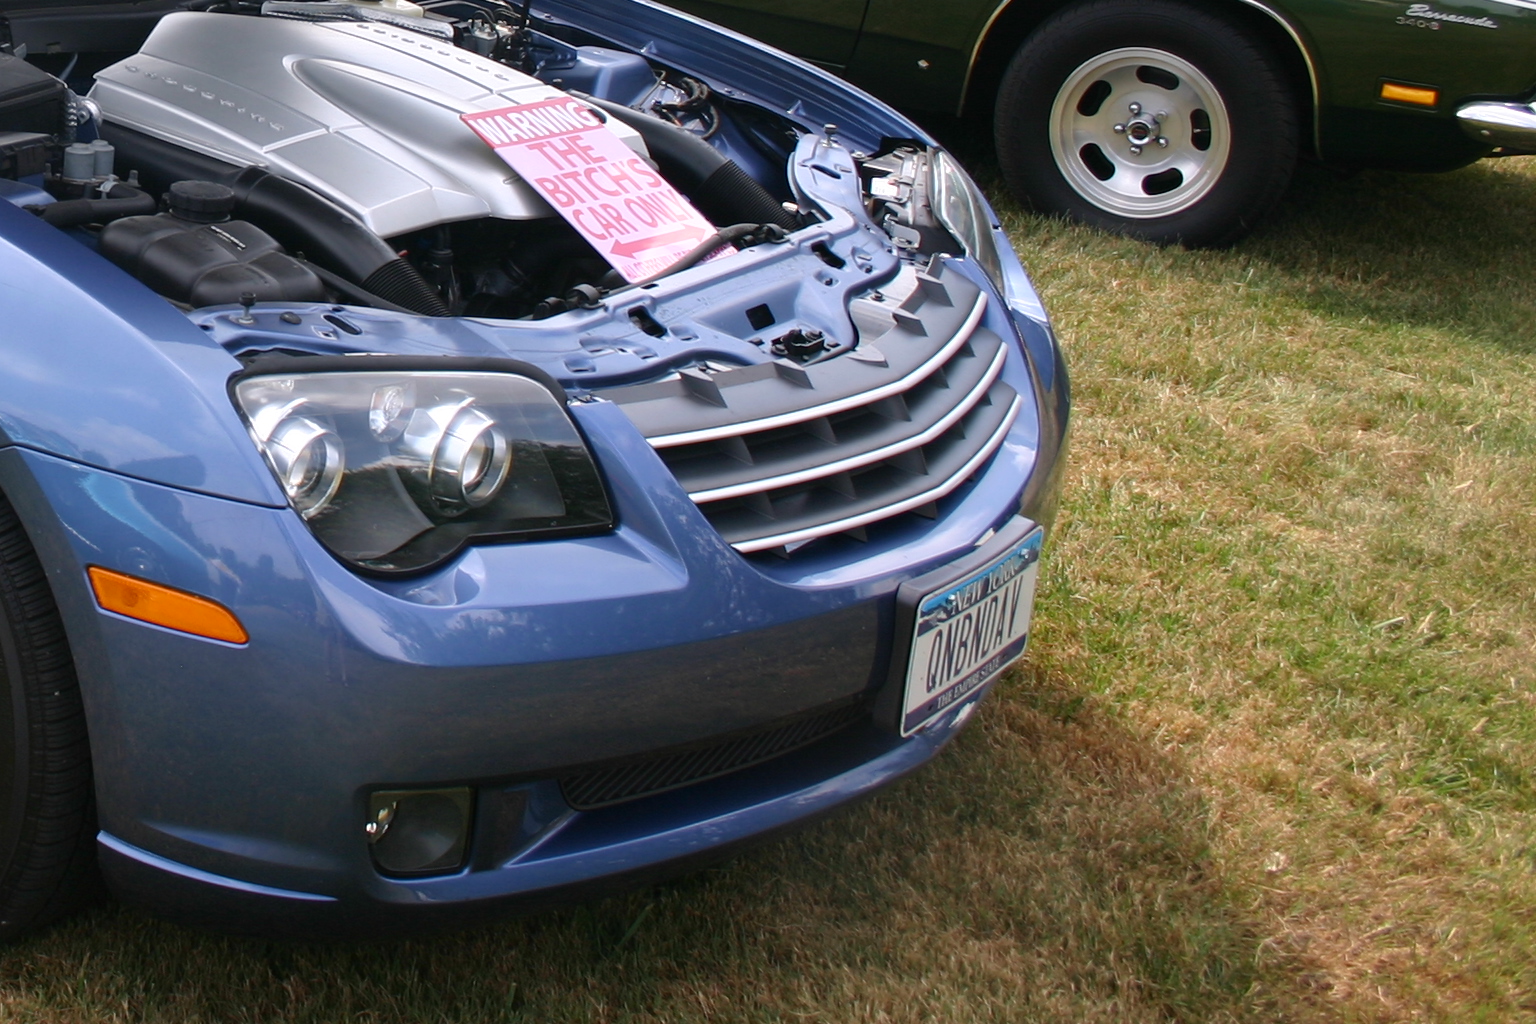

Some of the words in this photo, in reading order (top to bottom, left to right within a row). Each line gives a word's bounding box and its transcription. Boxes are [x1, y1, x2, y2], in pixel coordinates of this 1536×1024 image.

[1405, 3, 1498, 30] Barracuda
[468, 102, 601, 145] WARNING
[526, 134, 608, 171] THE
[534, 158, 662, 208] BITCH'S
[572, 203, 639, 241] CAR
[623, 189, 694, 228] ONLY
[952, 576, 985, 616] NEW
[987, 557, 1017, 594] YORK
[937, 689, 953, 709] THE
[953, 670, 981, 702] EMPIRE
[980, 656, 1001, 683] STATE
